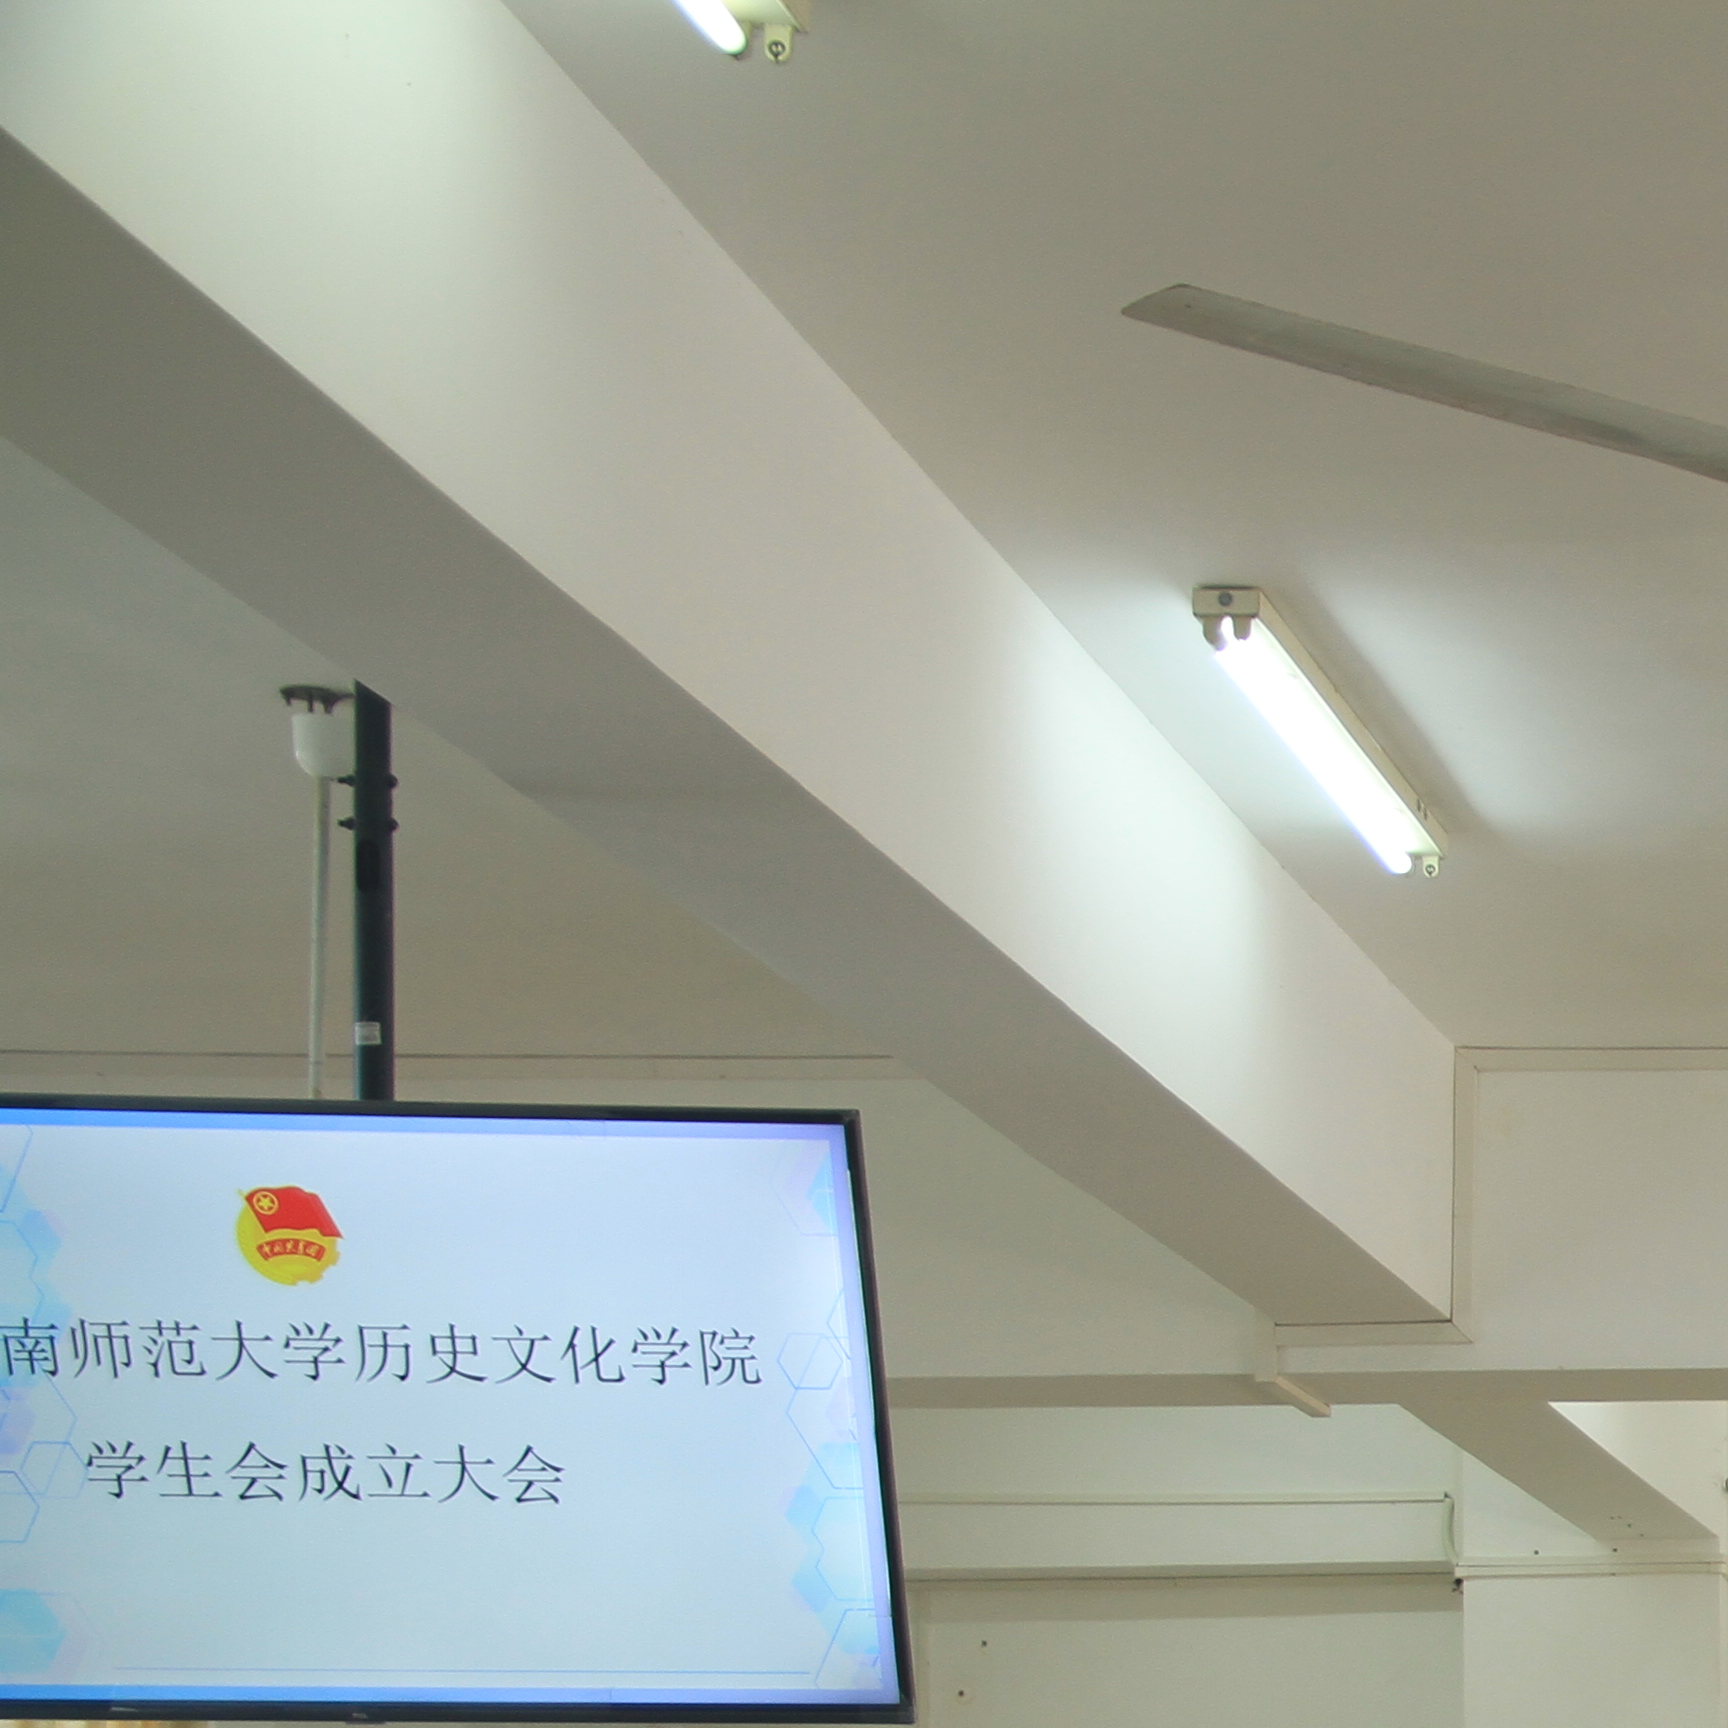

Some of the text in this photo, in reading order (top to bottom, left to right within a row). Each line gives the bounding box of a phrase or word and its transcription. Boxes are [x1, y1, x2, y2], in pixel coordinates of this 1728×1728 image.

[0, 1317, 762, 1386] 南师范大学历史文化学院
[86, 1440, 565, 1505] 学生会成立大会
